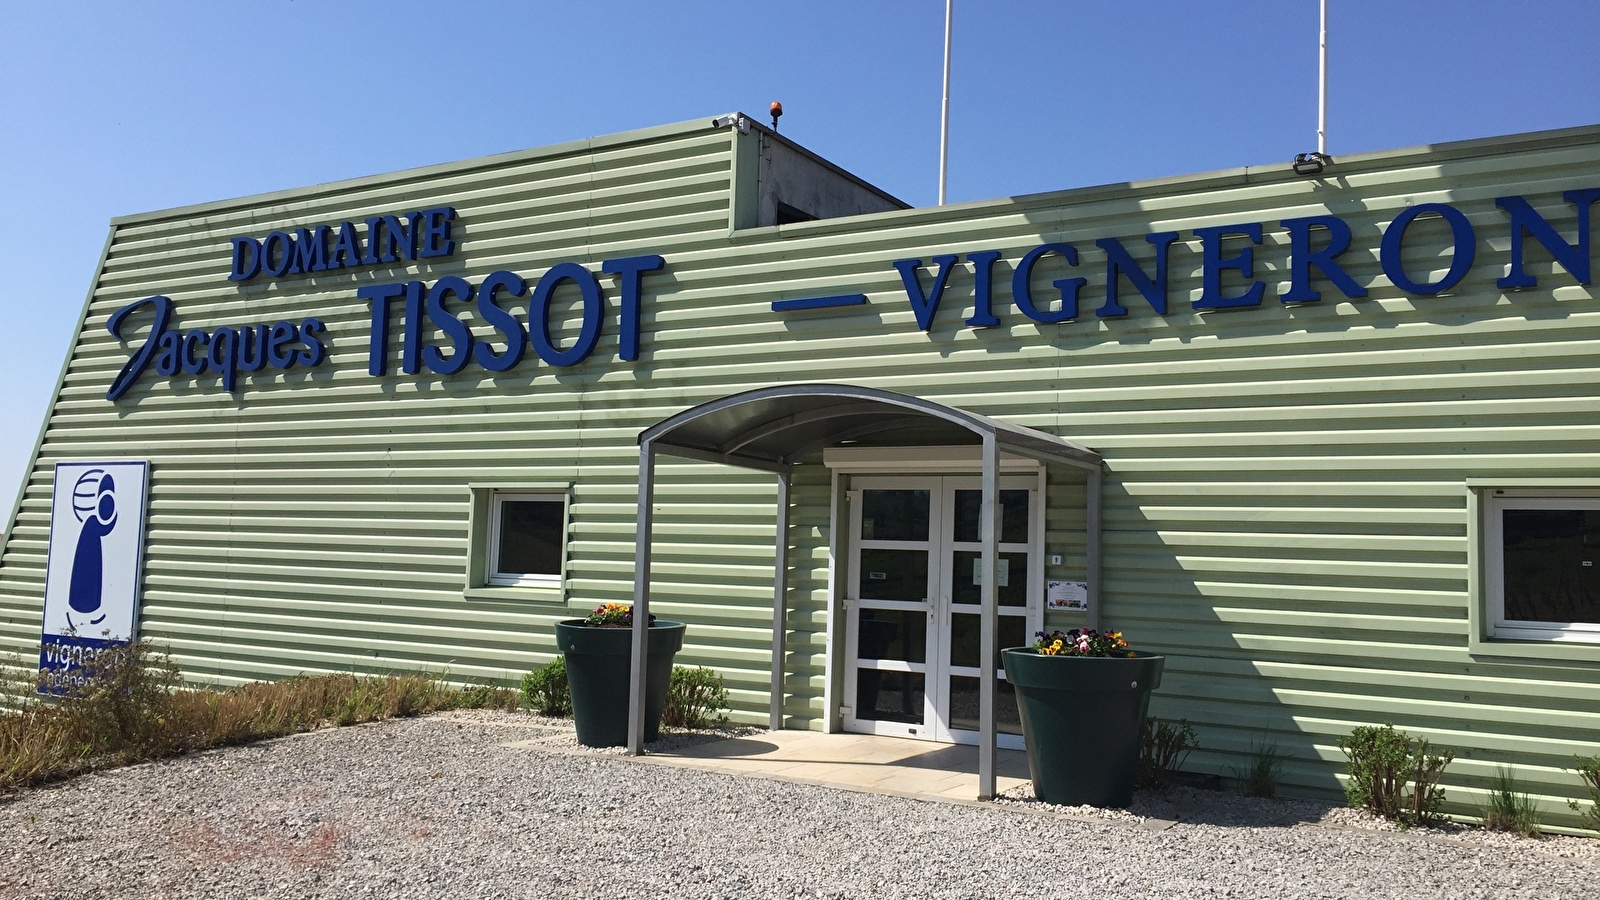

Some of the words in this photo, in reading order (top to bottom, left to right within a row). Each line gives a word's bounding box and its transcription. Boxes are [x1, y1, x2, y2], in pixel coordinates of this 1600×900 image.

[106, 295, 325, 400] Jacques
[357, 254, 665, 377] TISSOT
[893, 187, 1600, 333] VIGNERON
[228, 206, 456, 282] DOMAINE
